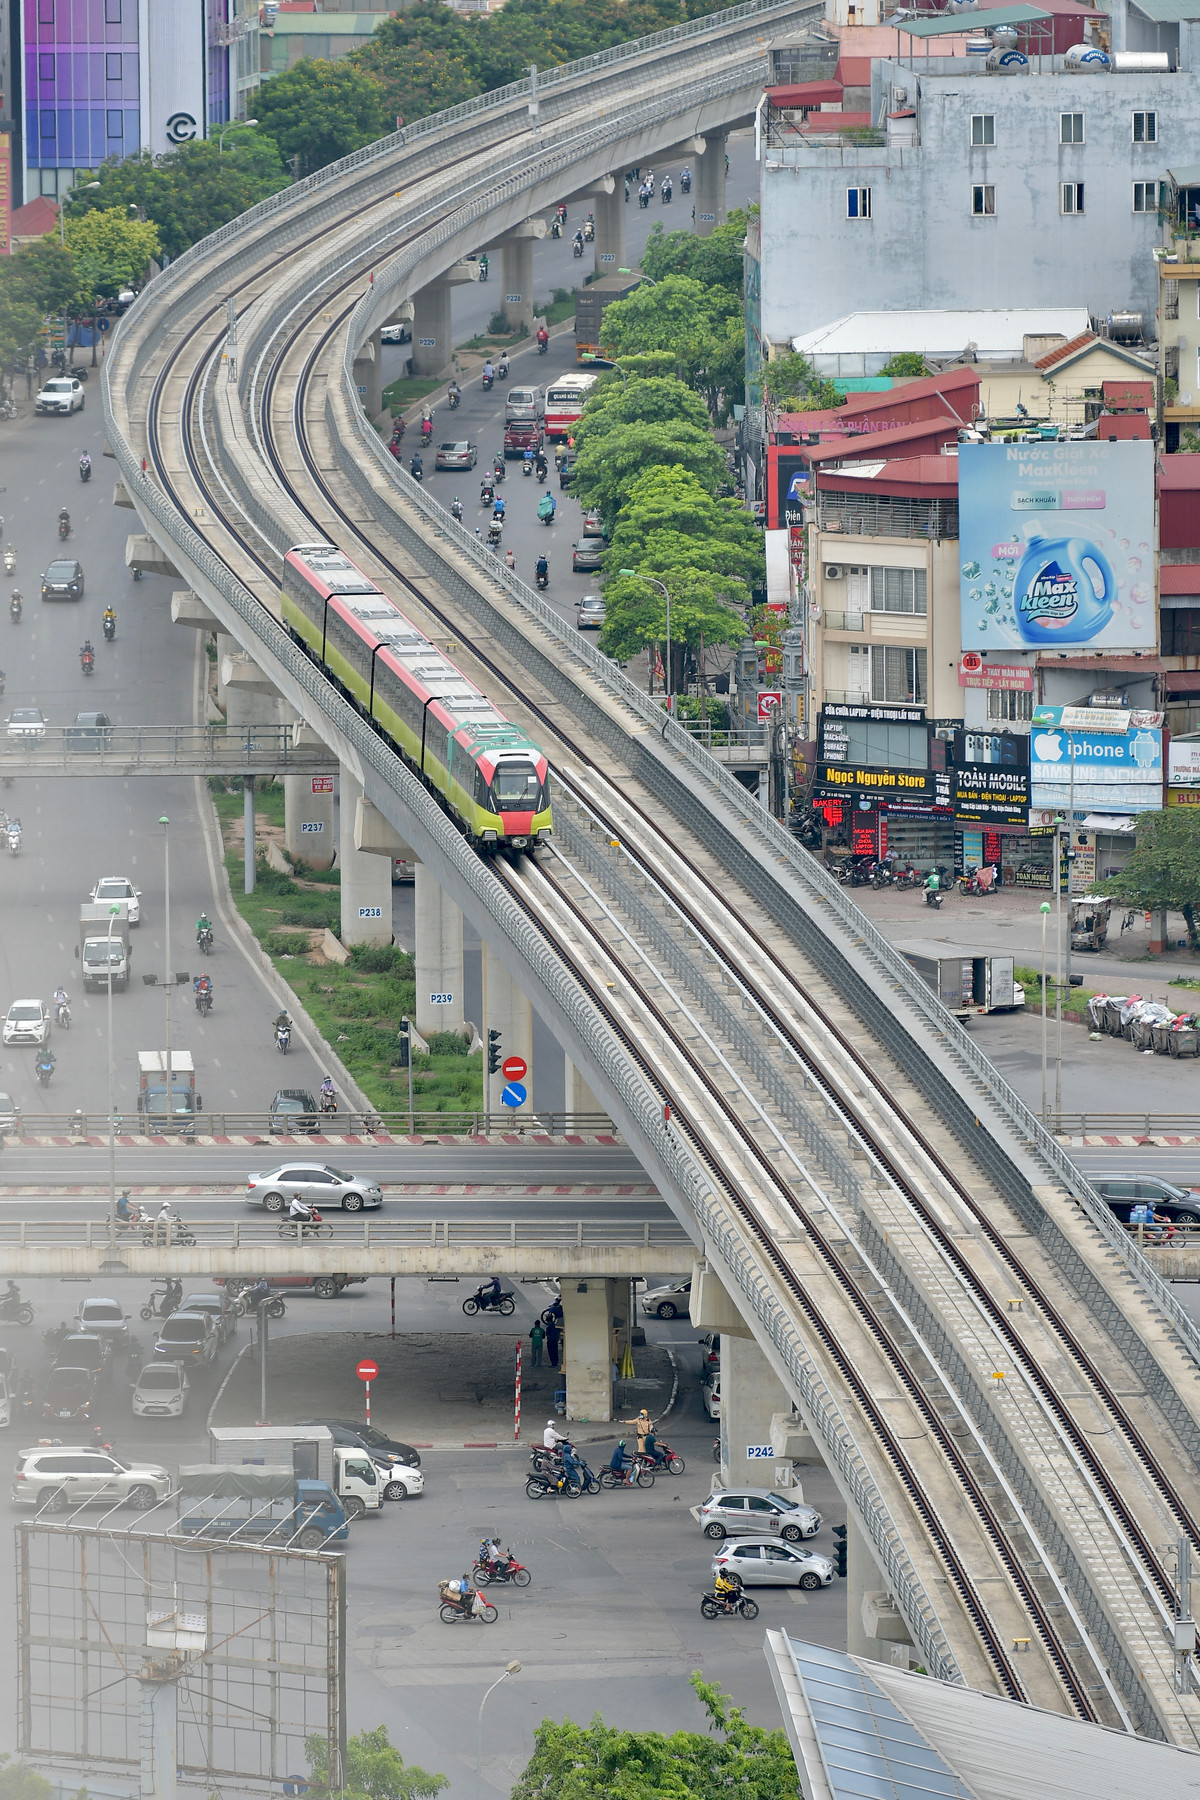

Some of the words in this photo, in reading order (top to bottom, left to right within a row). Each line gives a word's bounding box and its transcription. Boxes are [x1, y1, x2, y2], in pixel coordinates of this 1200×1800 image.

[848, 415, 879, 432] PHẦN
[1006, 448, 1050, 461] Nước
[1054, 447, 1085, 464] Giặt
[1019, 462, 1098, 477] MaxKleen
[1017, 496, 1034, 505] SẠCH
[1035, 494, 1057, 503] KHUẨN
[785, 510, 801, 525] Điện
[998, 546, 1020, 556] MỚI
[1034, 581, 1077, 597] Max
[1020, 594, 1075, 612] kleen
[987, 668, 1001, 677] THAY
[1002, 667, 1015, 678] MÀN
[1016, 668, 1030, 679] HÌNH
[966, 678, 981, 687] TRỰC
[982, 677, 995, 687] TIẾP
[998, 677, 1011, 688] LẤY
[825, 704, 835, 715] SỬA
[836, 706, 849, 716] CHỮA
[849, 708, 868, 718] LAPTOP
[824, 724, 843, 732] LAPTOP
[1068, 740, 1124, 758] iphone
[826, 768, 854, 787] Ngọc
[856, 770, 896, 787] Nguyễn
[898, 773, 926, 788] Store
[957, 767, 987, 789] TOÀN
[989, 773, 1027, 792] MOBILE
[813, 799, 843, 808] BAKERY
[957, 791, 968, 799] MUA
[968, 790, 979, 800] BÁN
[1009, 795, 1027, 804] LAPTOP
[302, 823, 323, 832] P237
[360, 908, 381, 917] P238
[431, 994, 453, 1003] P239
[748, 1446, 774, 1457] P242
